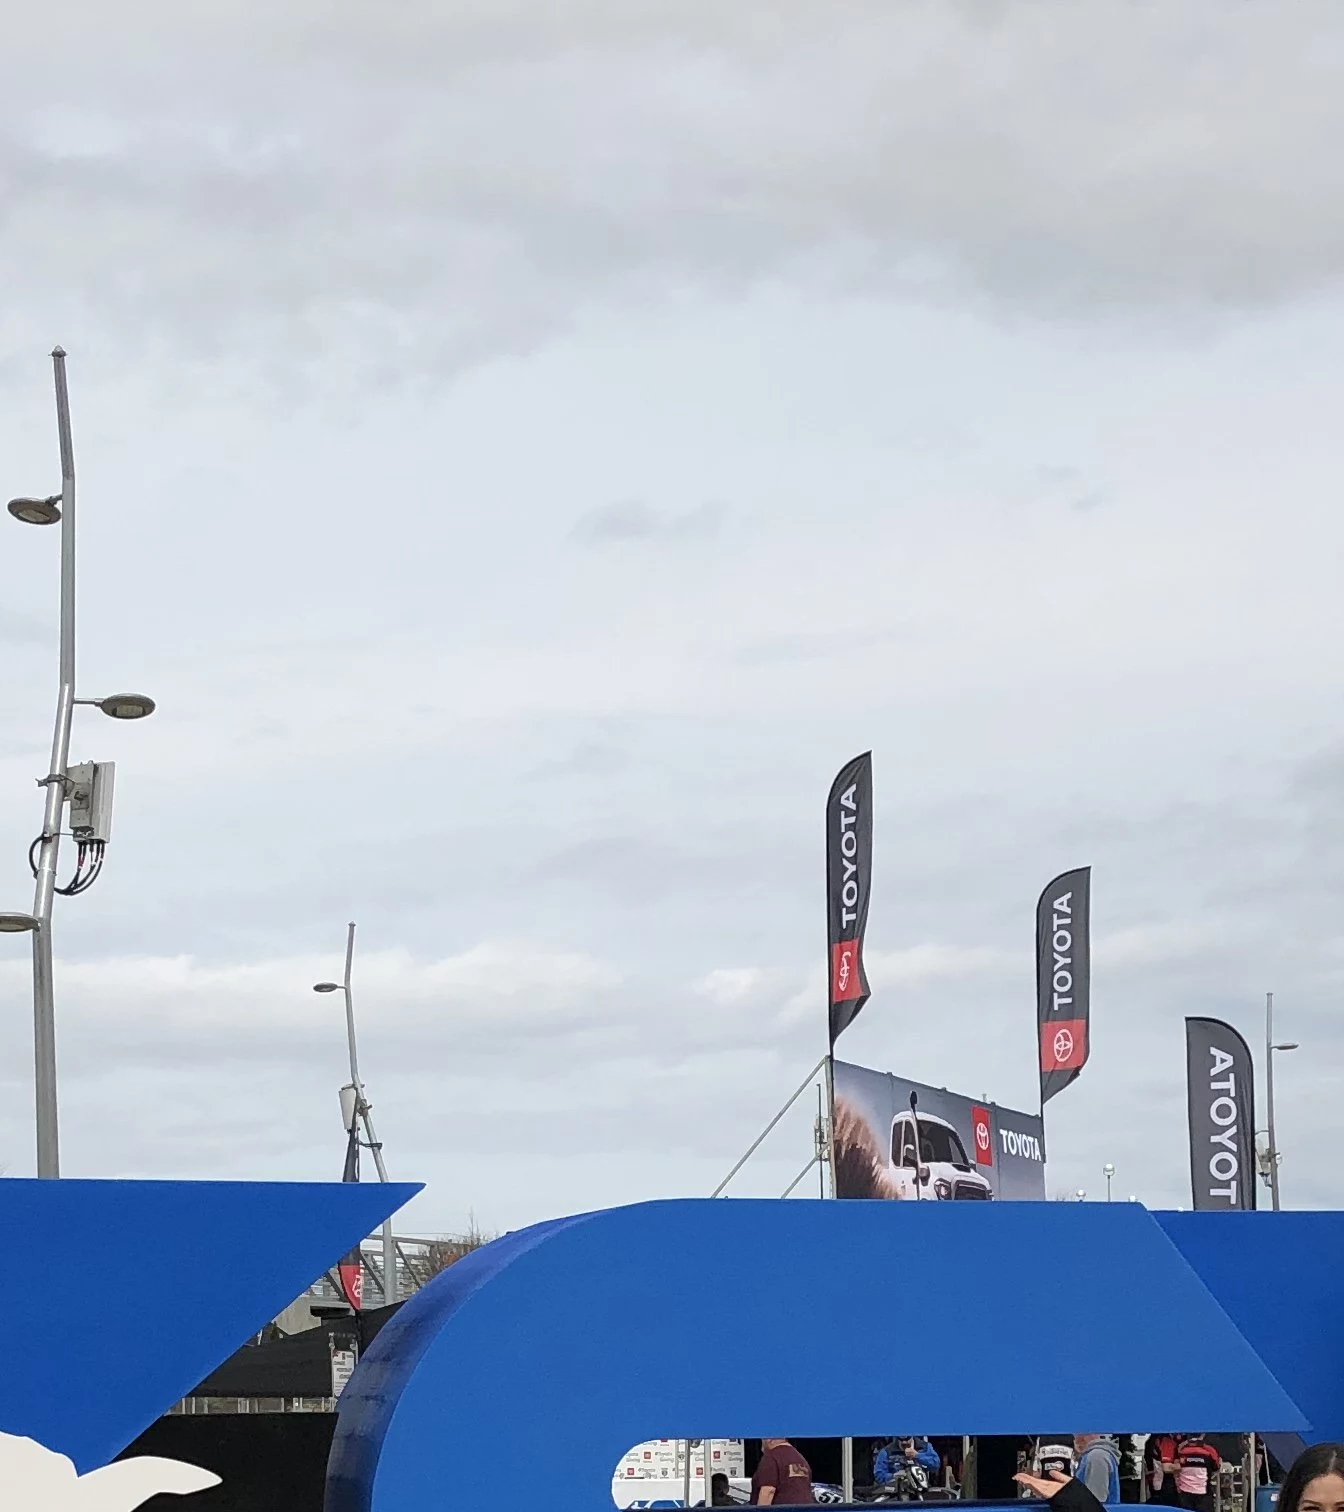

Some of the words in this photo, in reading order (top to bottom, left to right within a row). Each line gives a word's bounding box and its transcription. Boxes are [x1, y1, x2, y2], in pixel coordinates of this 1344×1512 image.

[840, 783, 858, 929] TOYOTA
[1052, 891, 1072, 1011] TOYOTA
[999, 1128, 1042, 1161] TOYOTA
